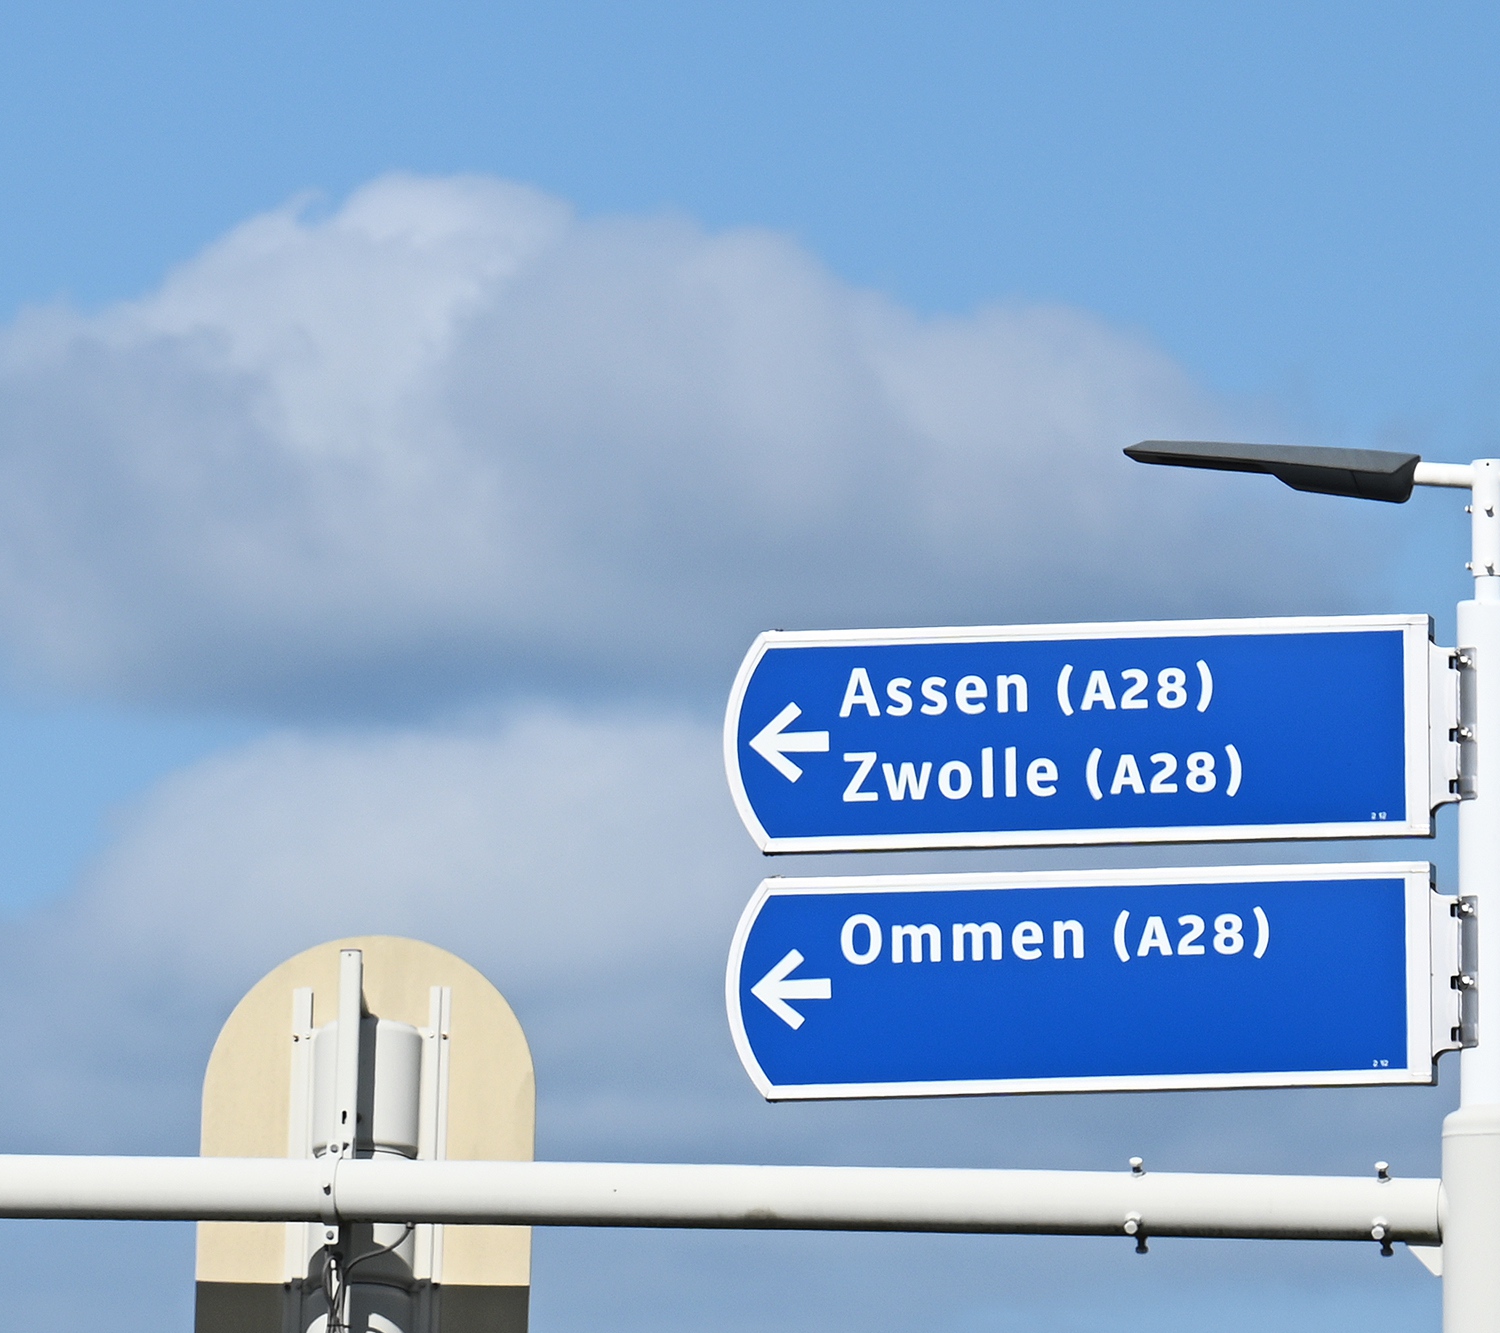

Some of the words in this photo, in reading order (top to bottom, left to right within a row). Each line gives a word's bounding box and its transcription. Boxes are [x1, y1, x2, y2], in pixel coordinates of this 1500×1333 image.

[838, 667, 1028, 718] Assen
[1056, 659, 1213, 717] (A28)
[842, 746, 1059, 803] Zwolle
[1085, 743, 1242, 801] (A28)
[840, 913, 1085, 966] Ommen
[1113, 906, 1270, 963] (A28)
